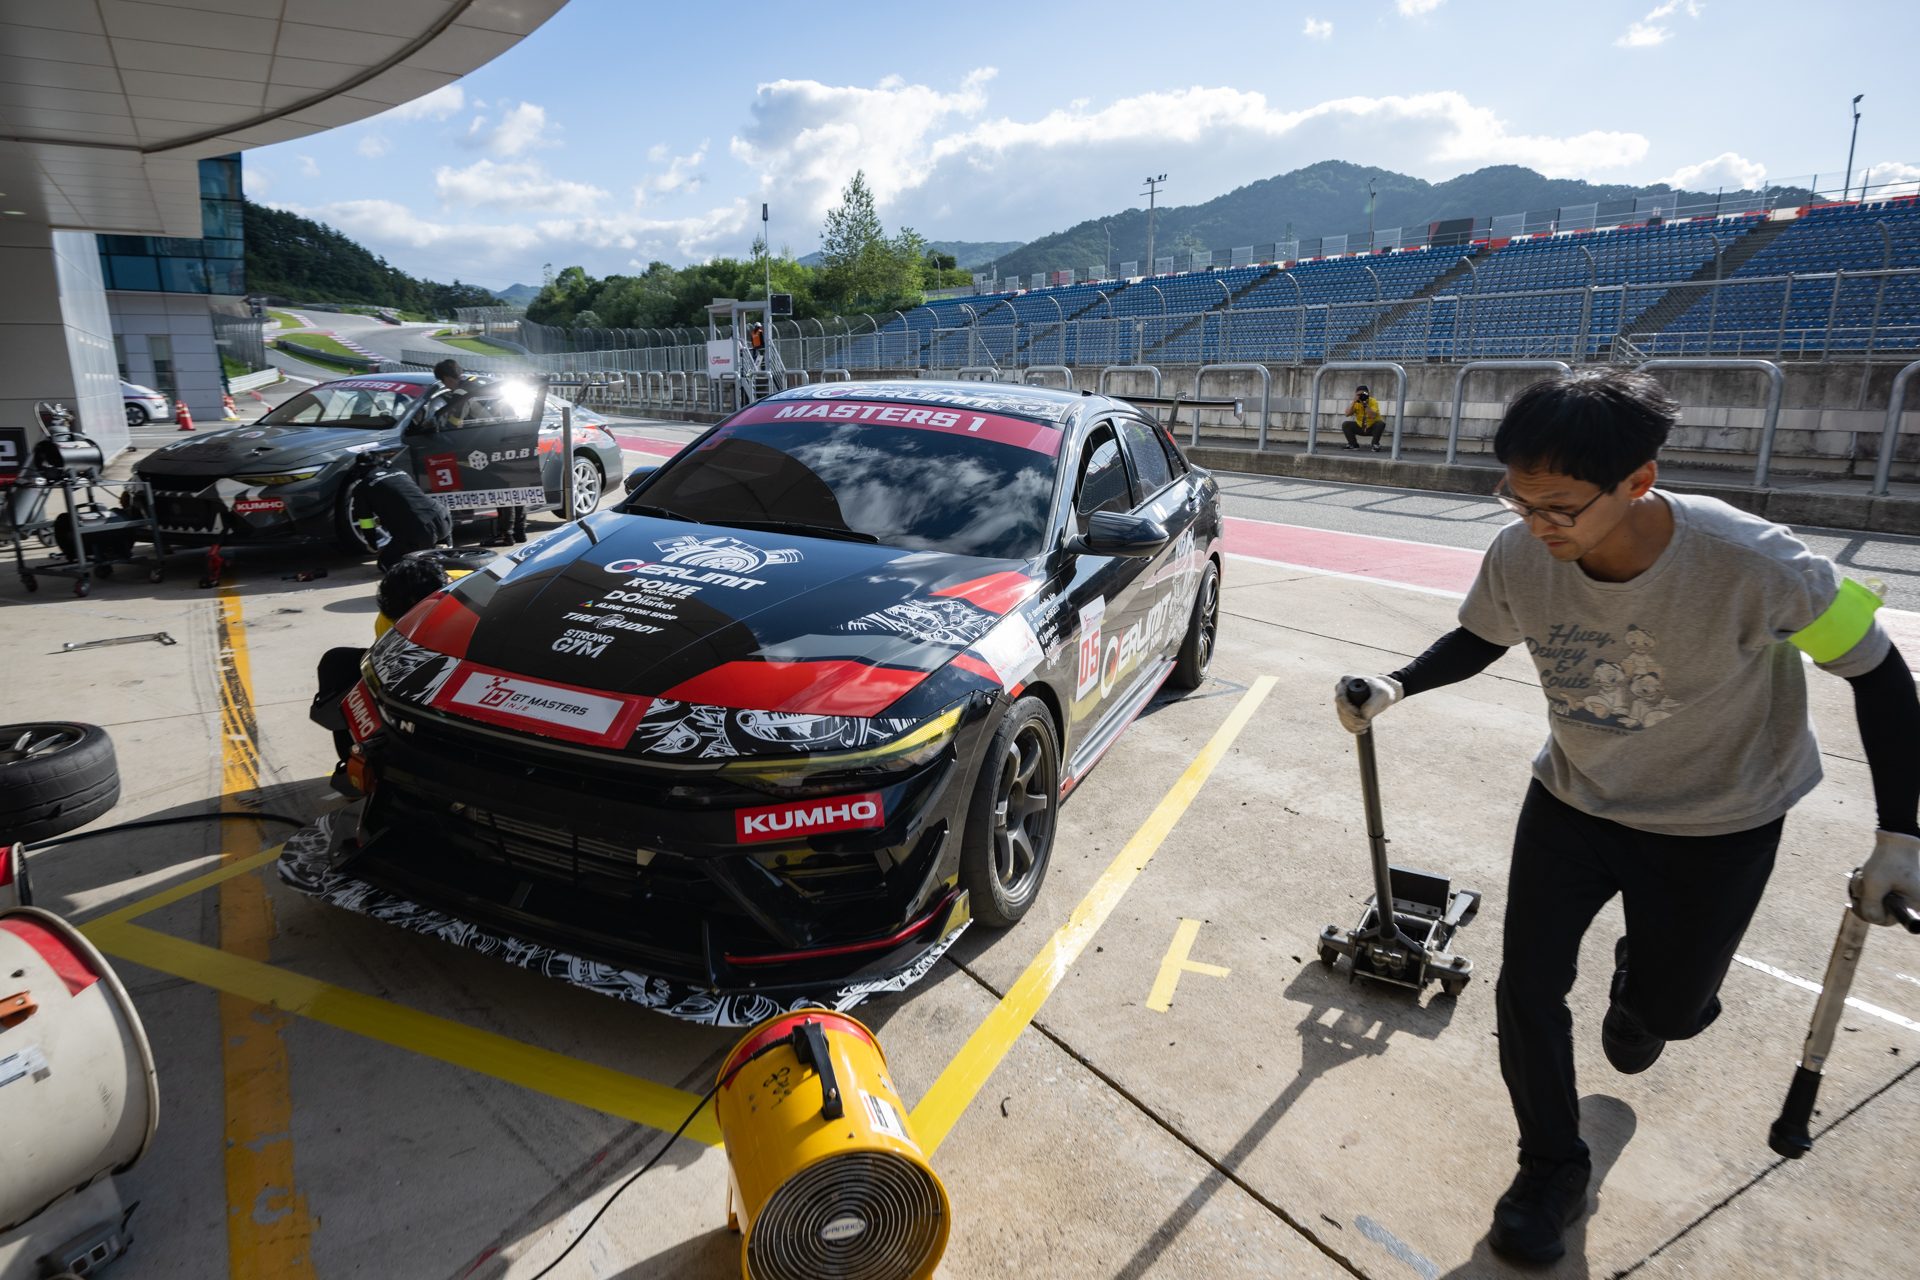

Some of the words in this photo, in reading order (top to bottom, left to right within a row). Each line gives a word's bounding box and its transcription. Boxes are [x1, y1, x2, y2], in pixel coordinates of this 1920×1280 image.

[774, 404, 961, 428] MASTERS
[968, 416, 986, 432] 1
[436, 469, 454, 487] 3
[236, 501, 284, 511] KUMHO
[623, 578, 704, 596] ROWE
[640, 588, 673, 598] MOTOR
[672, 592, 687, 600] OIL
[603, 590, 642, 603] DO
[635, 598, 677, 610] Market
[562, 612, 601, 623] TIRE
[649, 612, 679, 620] SHOP
[563, 628, 615, 644] STRONG
[552, 637, 608, 659] GYM
[1079, 629, 1101, 688] 05
[1555, 660, 1571, 673] &
[504, 703, 529, 712] INJE
[510, 693, 531, 702] GT
[530, 697, 589, 716] MASTERS
[347, 688, 376, 738] KUMHO
[744, 801, 877, 834] KUMHO
